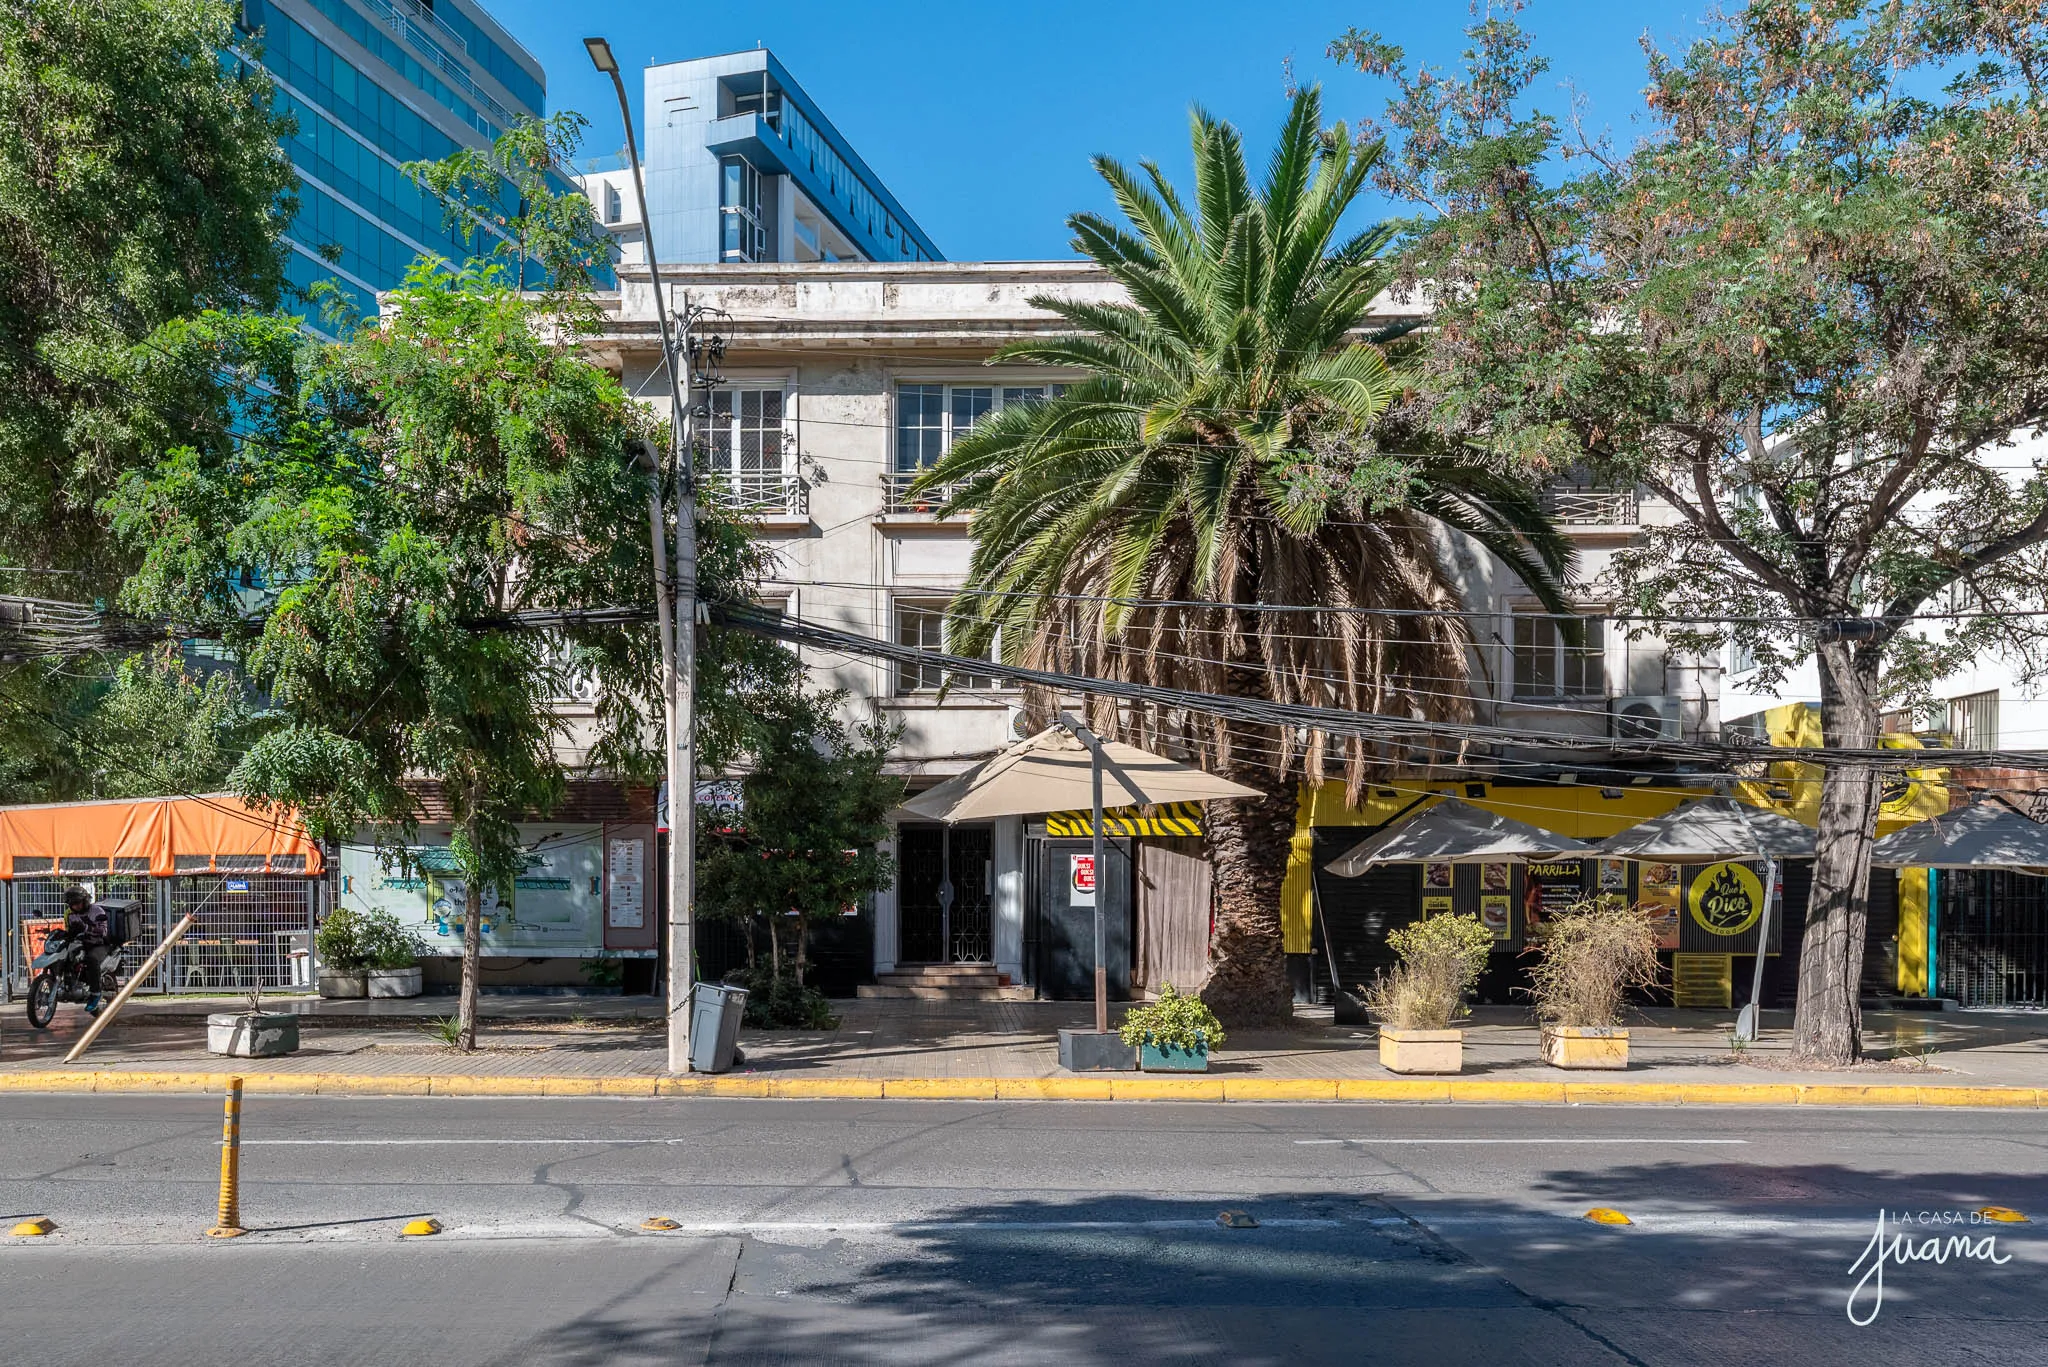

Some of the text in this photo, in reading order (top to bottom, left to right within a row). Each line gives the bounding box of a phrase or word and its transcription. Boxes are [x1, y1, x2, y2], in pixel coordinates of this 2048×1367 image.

[1528, 865, 1580, 876] PARRILLA
[1721, 883, 1738, 896] Que
[1708, 896, 1745, 922] Rico
